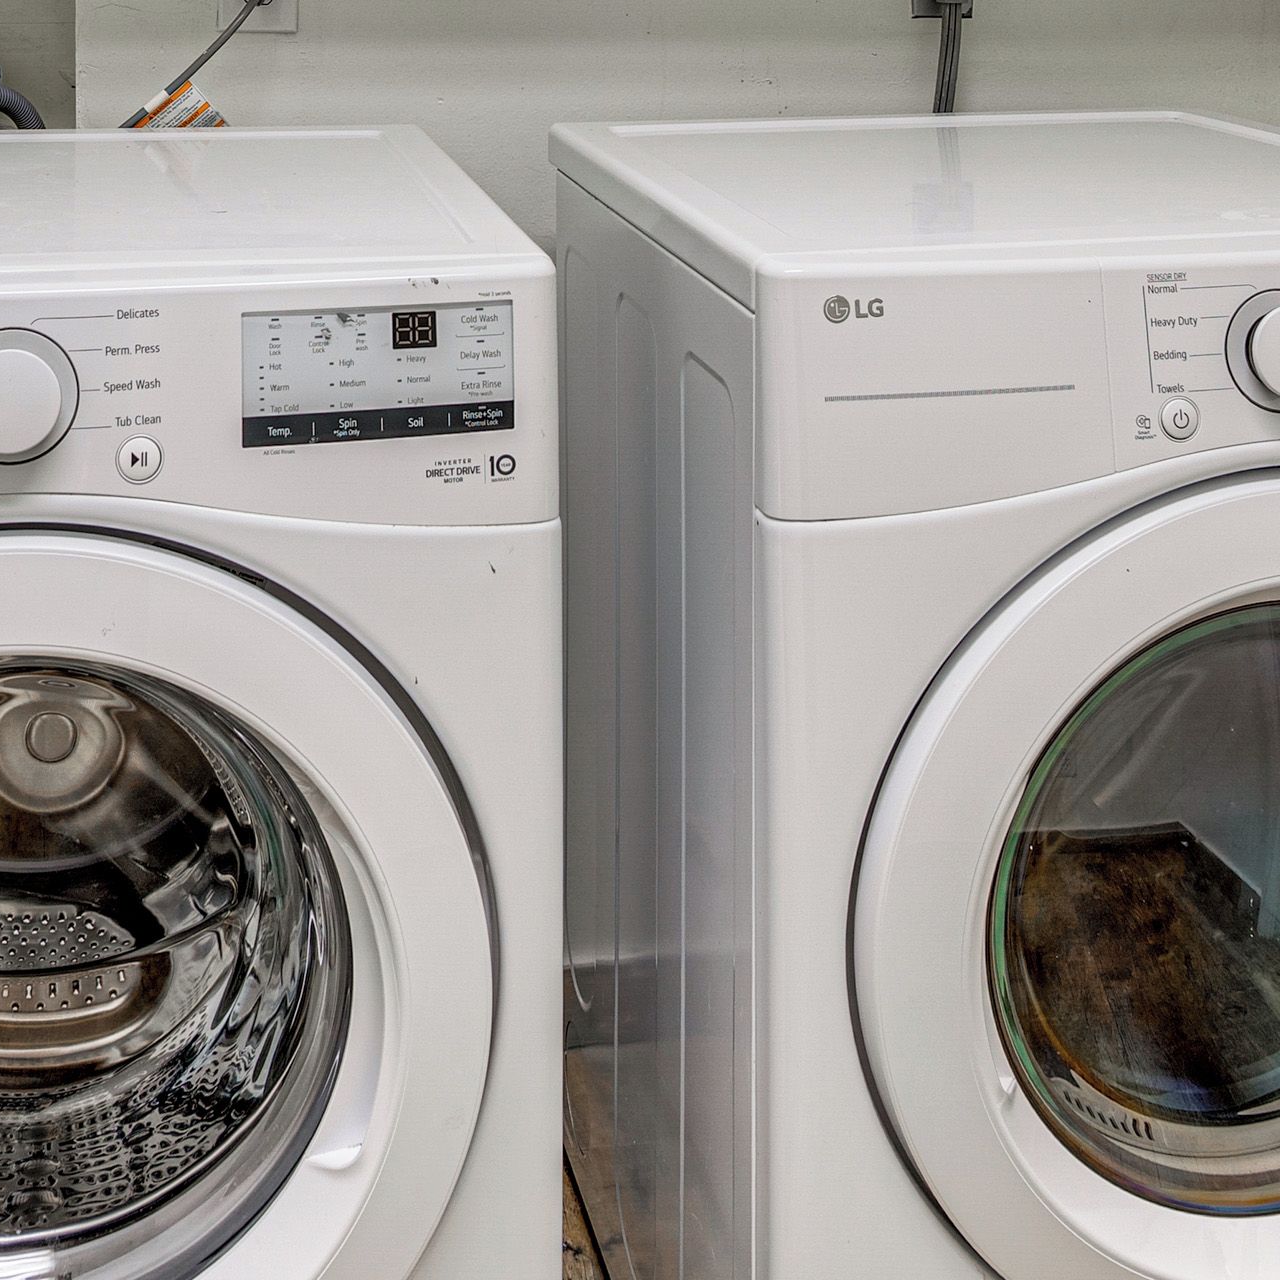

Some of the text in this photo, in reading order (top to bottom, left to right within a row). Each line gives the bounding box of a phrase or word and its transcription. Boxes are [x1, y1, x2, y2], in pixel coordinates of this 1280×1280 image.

[1147, 272, 1187, 281] SENSOR DRY
[1147, 284, 1178, 294] Normal
[116, 306, 160, 320] Delicates
[854, 298, 884, 319] LG
[461, 314, 499, 324] Cold Wash
[1150, 316, 1198, 329] Heavy Duty
[105, 342, 161, 356] Perm. Press
[406, 355, 427, 364] Heavy
[460, 349, 502, 360] Delay Wash
[1153, 350, 1187, 361] Bedding
[339, 359, 355, 368] High
[339, 379, 366, 387] Medium
[406, 374, 431, 383] Normal
[103, 377, 161, 393] Speed Wash
[270, 384, 290, 392] Warm
[461, 379, 502, 390] Extra Rinse
[1157, 383, 1185, 393] Towels
[340, 401, 354, 409] Low
[407, 395, 424, 405] Light
[270, 404, 299, 413] Tap Cold
[462, 408, 503, 420] Rinse+Spin
[115, 414, 162, 427] Tub Clean
[338, 418, 358, 429] Spin
[408, 417, 424, 427] Soil
[486, 418, 498, 426] Lock
[267, 426, 293, 437] Temp.
[348, 429, 361, 437] Only
[434, 458, 472, 466] INVERTER
[489, 454, 516, 476] 10
[426, 465, 481, 478] DIRECT DRIVE
